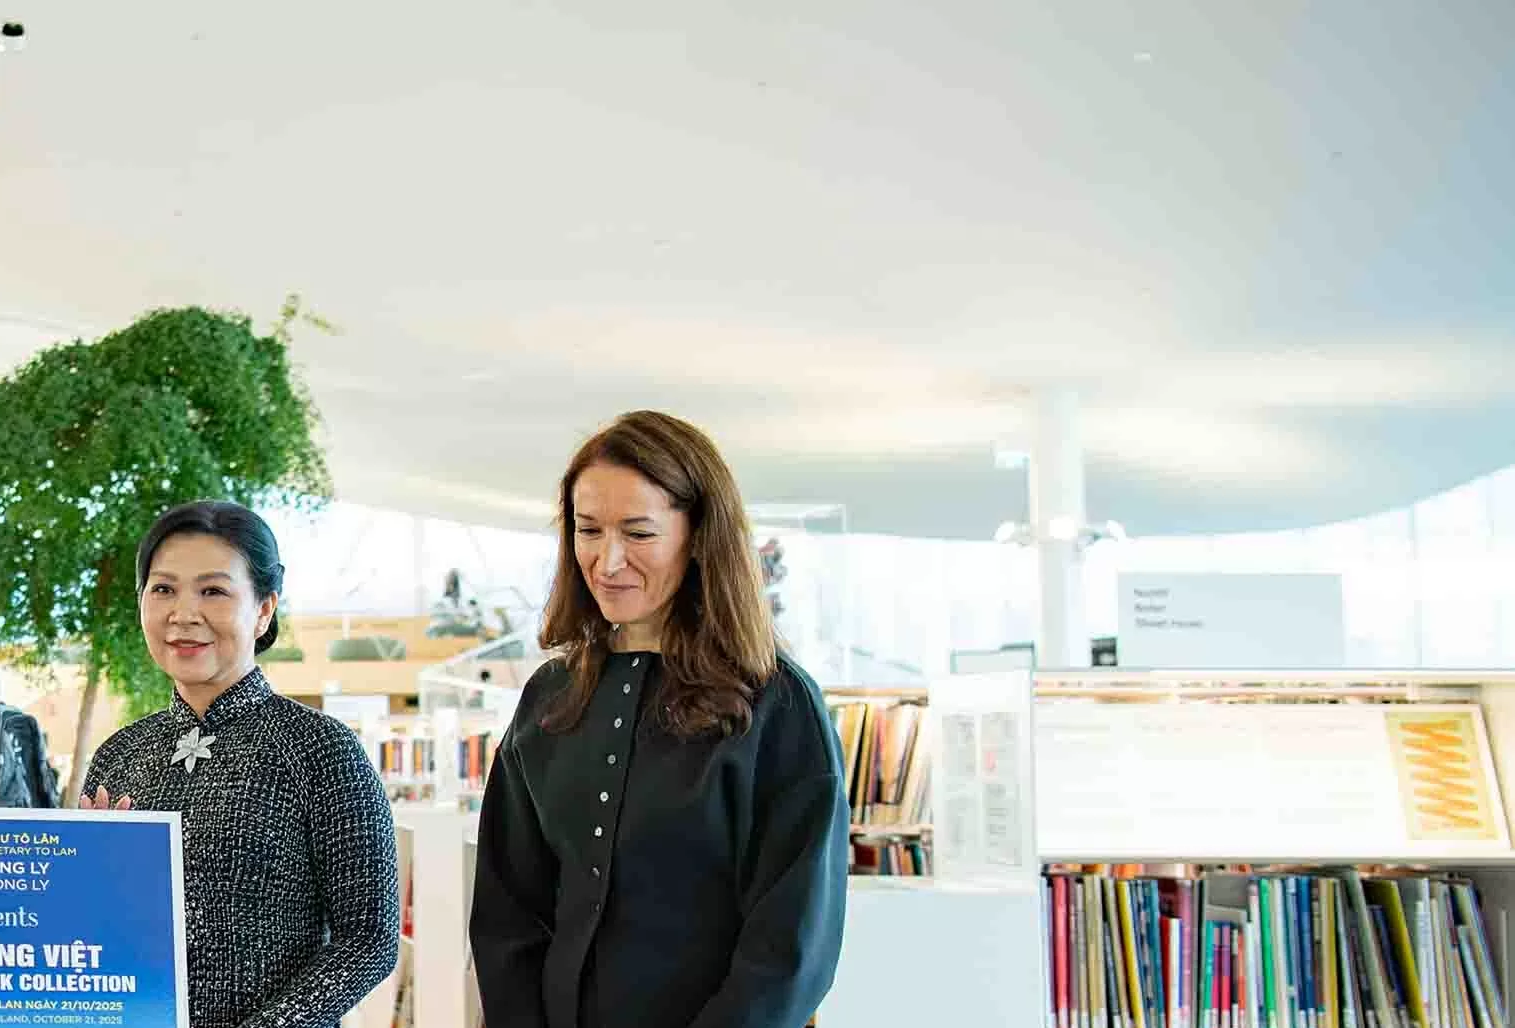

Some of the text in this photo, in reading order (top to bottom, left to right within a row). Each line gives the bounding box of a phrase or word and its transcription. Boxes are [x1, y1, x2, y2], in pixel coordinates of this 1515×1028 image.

[13, 833, 30, 844] TÔ
[34, 834, 59, 845] LÂM
[35, 847, 50, 856] TO
[53, 847, 77, 857] LAM
[30, 862, 50, 874] LY
[32, 880, 50, 891] LY
[43, 940, 103, 973] VIỆT
[19, 974, 136, 993] COLLECTION
[25, 999, 58, 1010] NGÀY
[61, 1000, 123, 1011] 21/10/2025
[33, 1015, 83, 1024] OCTOBER
[99, 1016, 123, 1025] 2025
